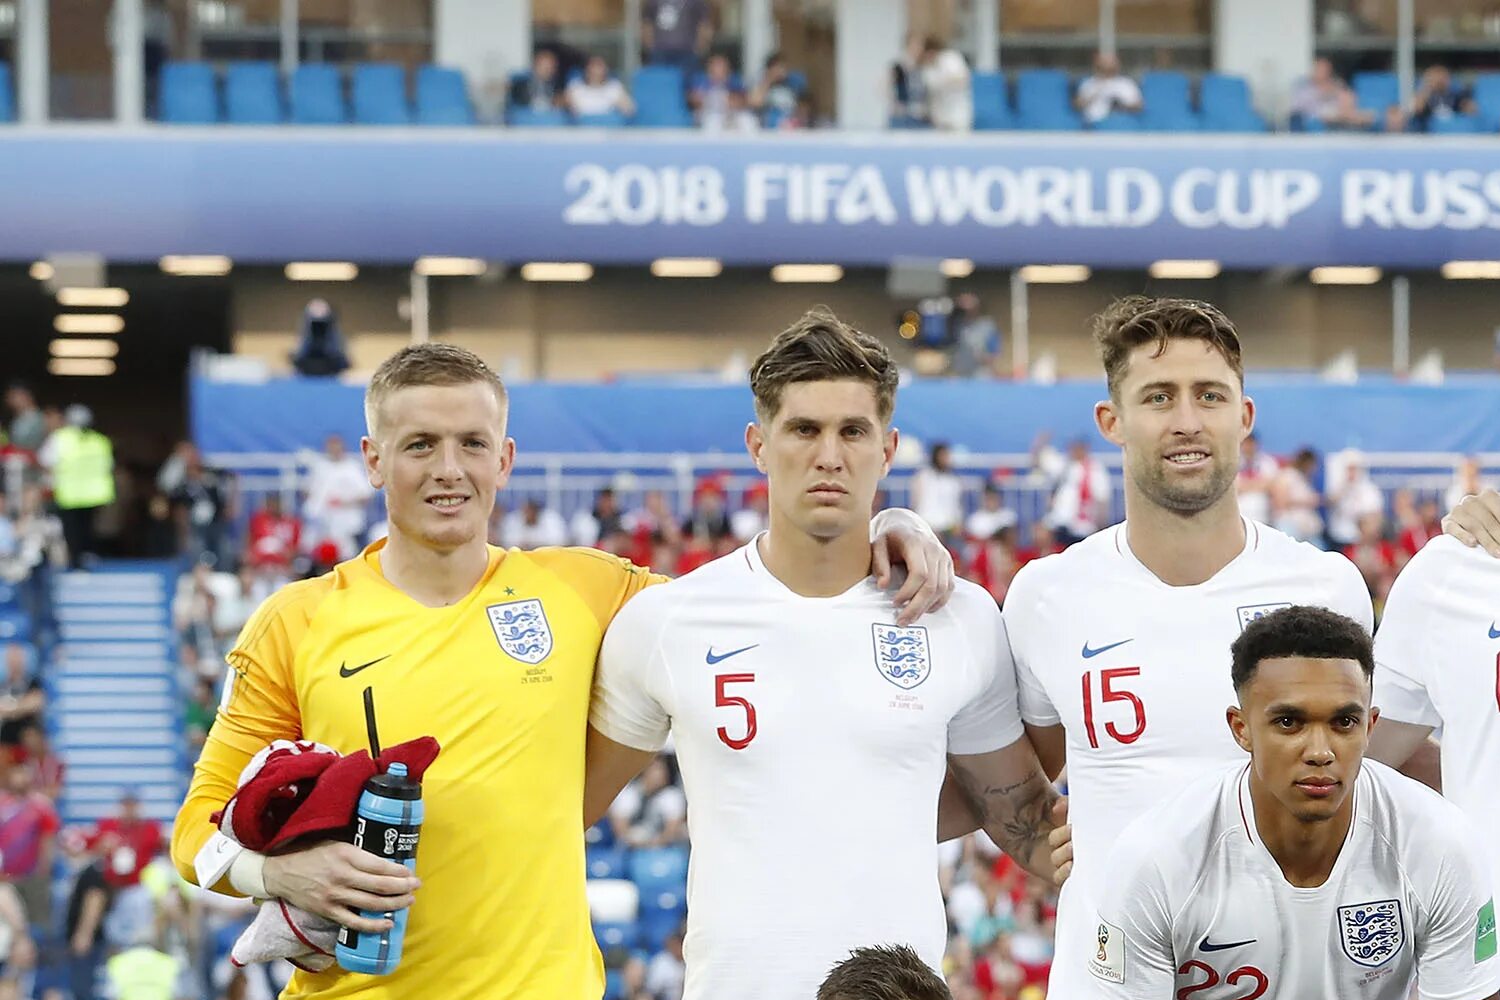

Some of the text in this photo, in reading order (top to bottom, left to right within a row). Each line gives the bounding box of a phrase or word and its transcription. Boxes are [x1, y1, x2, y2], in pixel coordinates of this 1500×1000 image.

[563, 162, 729, 226] 2018
[743, 162, 898, 225] FIFA
[904, 164, 1164, 228] WORLD
[1169, 166, 1323, 230] CUP
[713, 671, 758, 751] 5
[1081, 665, 1148, 749] 15
